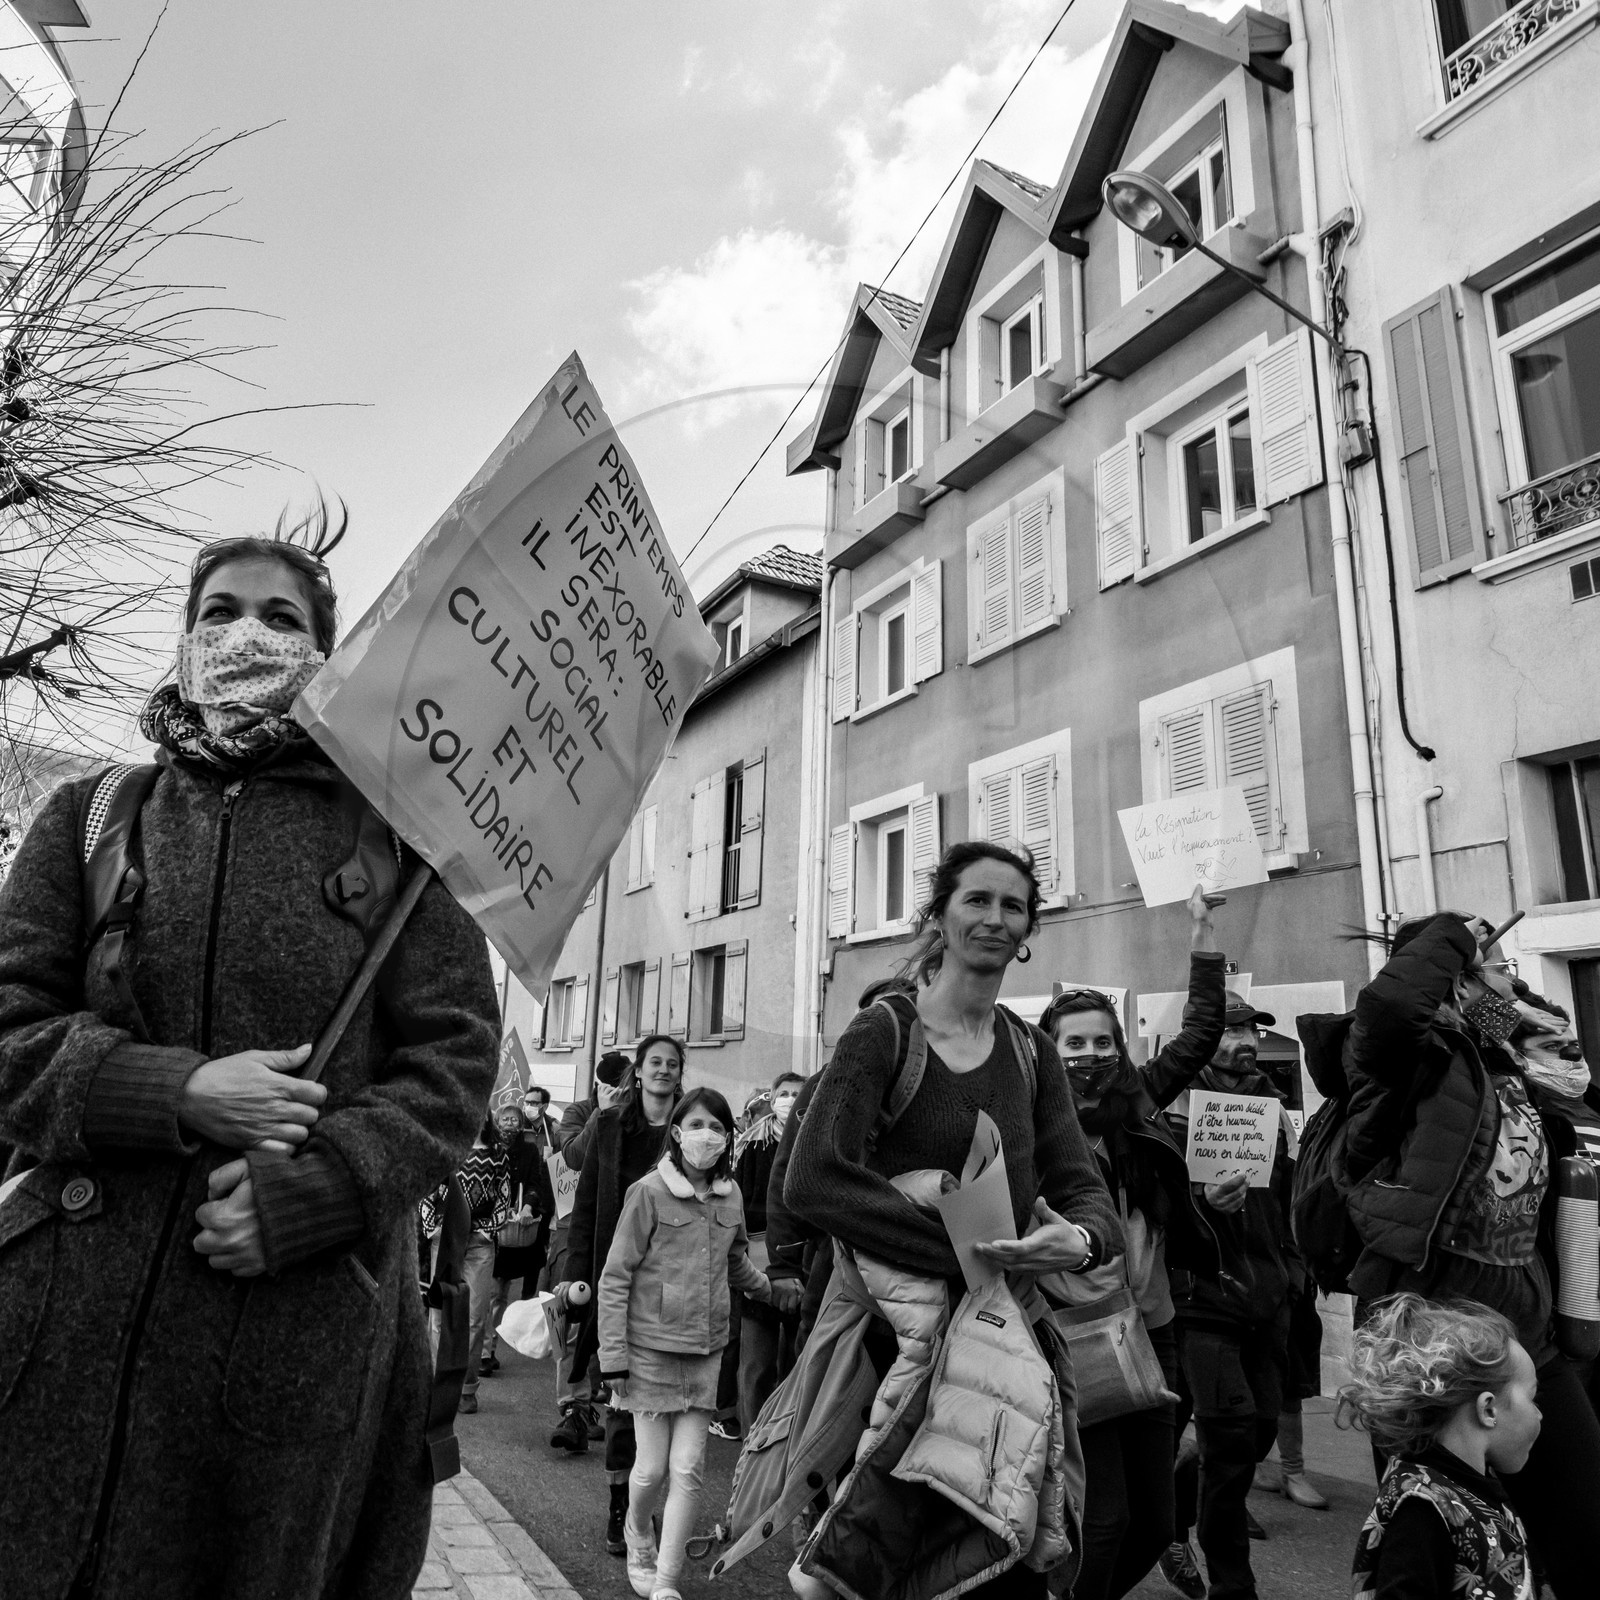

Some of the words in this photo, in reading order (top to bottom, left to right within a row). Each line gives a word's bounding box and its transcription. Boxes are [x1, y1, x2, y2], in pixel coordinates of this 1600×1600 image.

[561, 384, 597, 437] LE
[584, 481, 637, 558] EST
[448, 586, 585, 805] CULTUREL
[492, 724, 537, 785] ET
[1197, 1114, 1223, 1127] d'être
[1224, 1103, 1243, 1112] avons
[1193, 1129, 1204, 1142] et
[1207, 1132, 1229, 1141] rien
[1231, 1133, 1240, 1141] ne
[1195, 1147, 1217, 1159] nous
[1221, 1148, 1232, 1159] en
